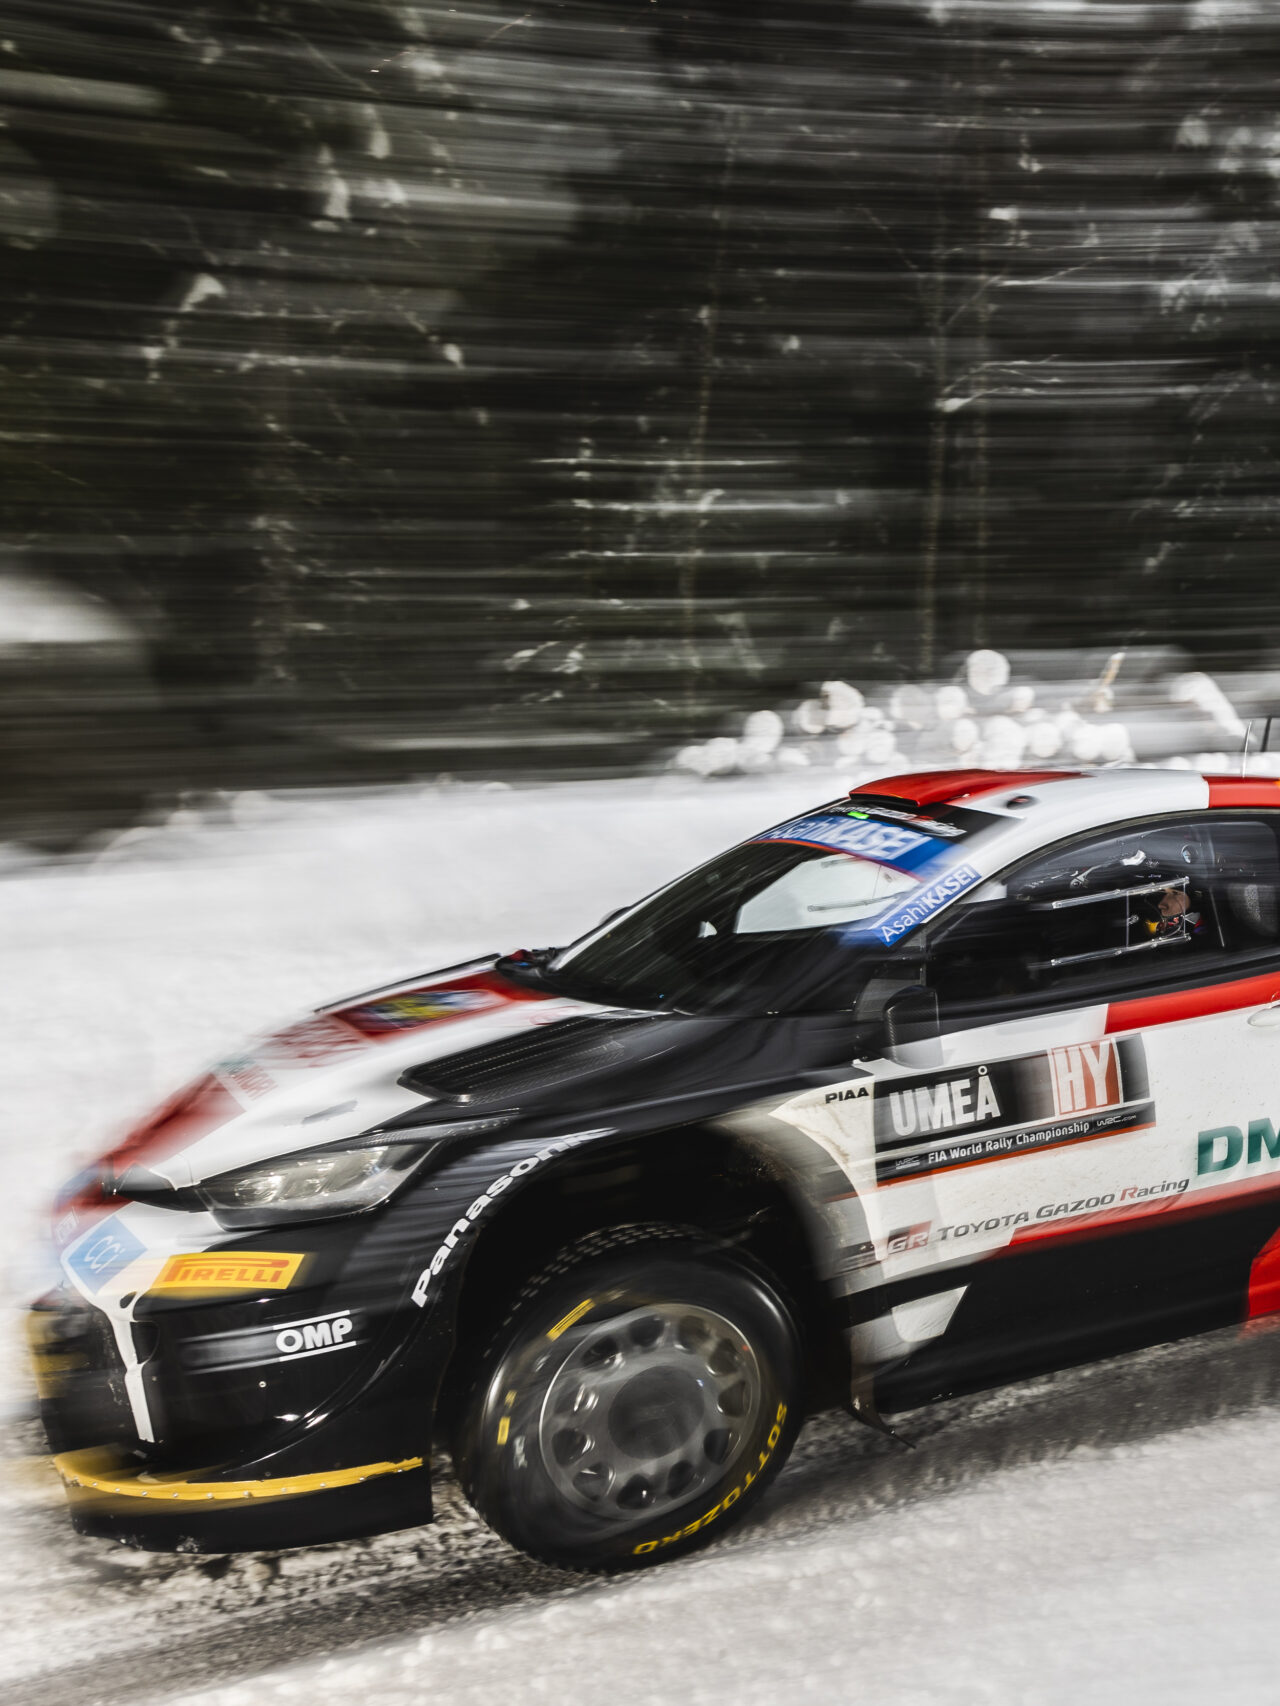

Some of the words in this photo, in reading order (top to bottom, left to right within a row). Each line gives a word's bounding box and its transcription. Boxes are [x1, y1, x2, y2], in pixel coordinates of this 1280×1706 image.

[880, 865, 977, 943] AsahiKASEI
[825, 1086, 870, 1103] PIAA
[889, 1065, 1001, 1138] UMEÅ
[1051, 1042, 1114, 1114] HY
[927, 1149, 947, 1165] FIA
[949, 1144, 983, 1159] World
[985, 1138, 1014, 1152] Rally
[1015, 1120, 1090, 1148] Championship
[936, 1211, 1030, 1242] TOYOTA
[1035, 1193, 1117, 1220] GAZOO
[1119, 1178, 1191, 1202] Racing
[162, 1257, 291, 1284] PIRELLI
[275, 1317, 353, 1353] OMP
